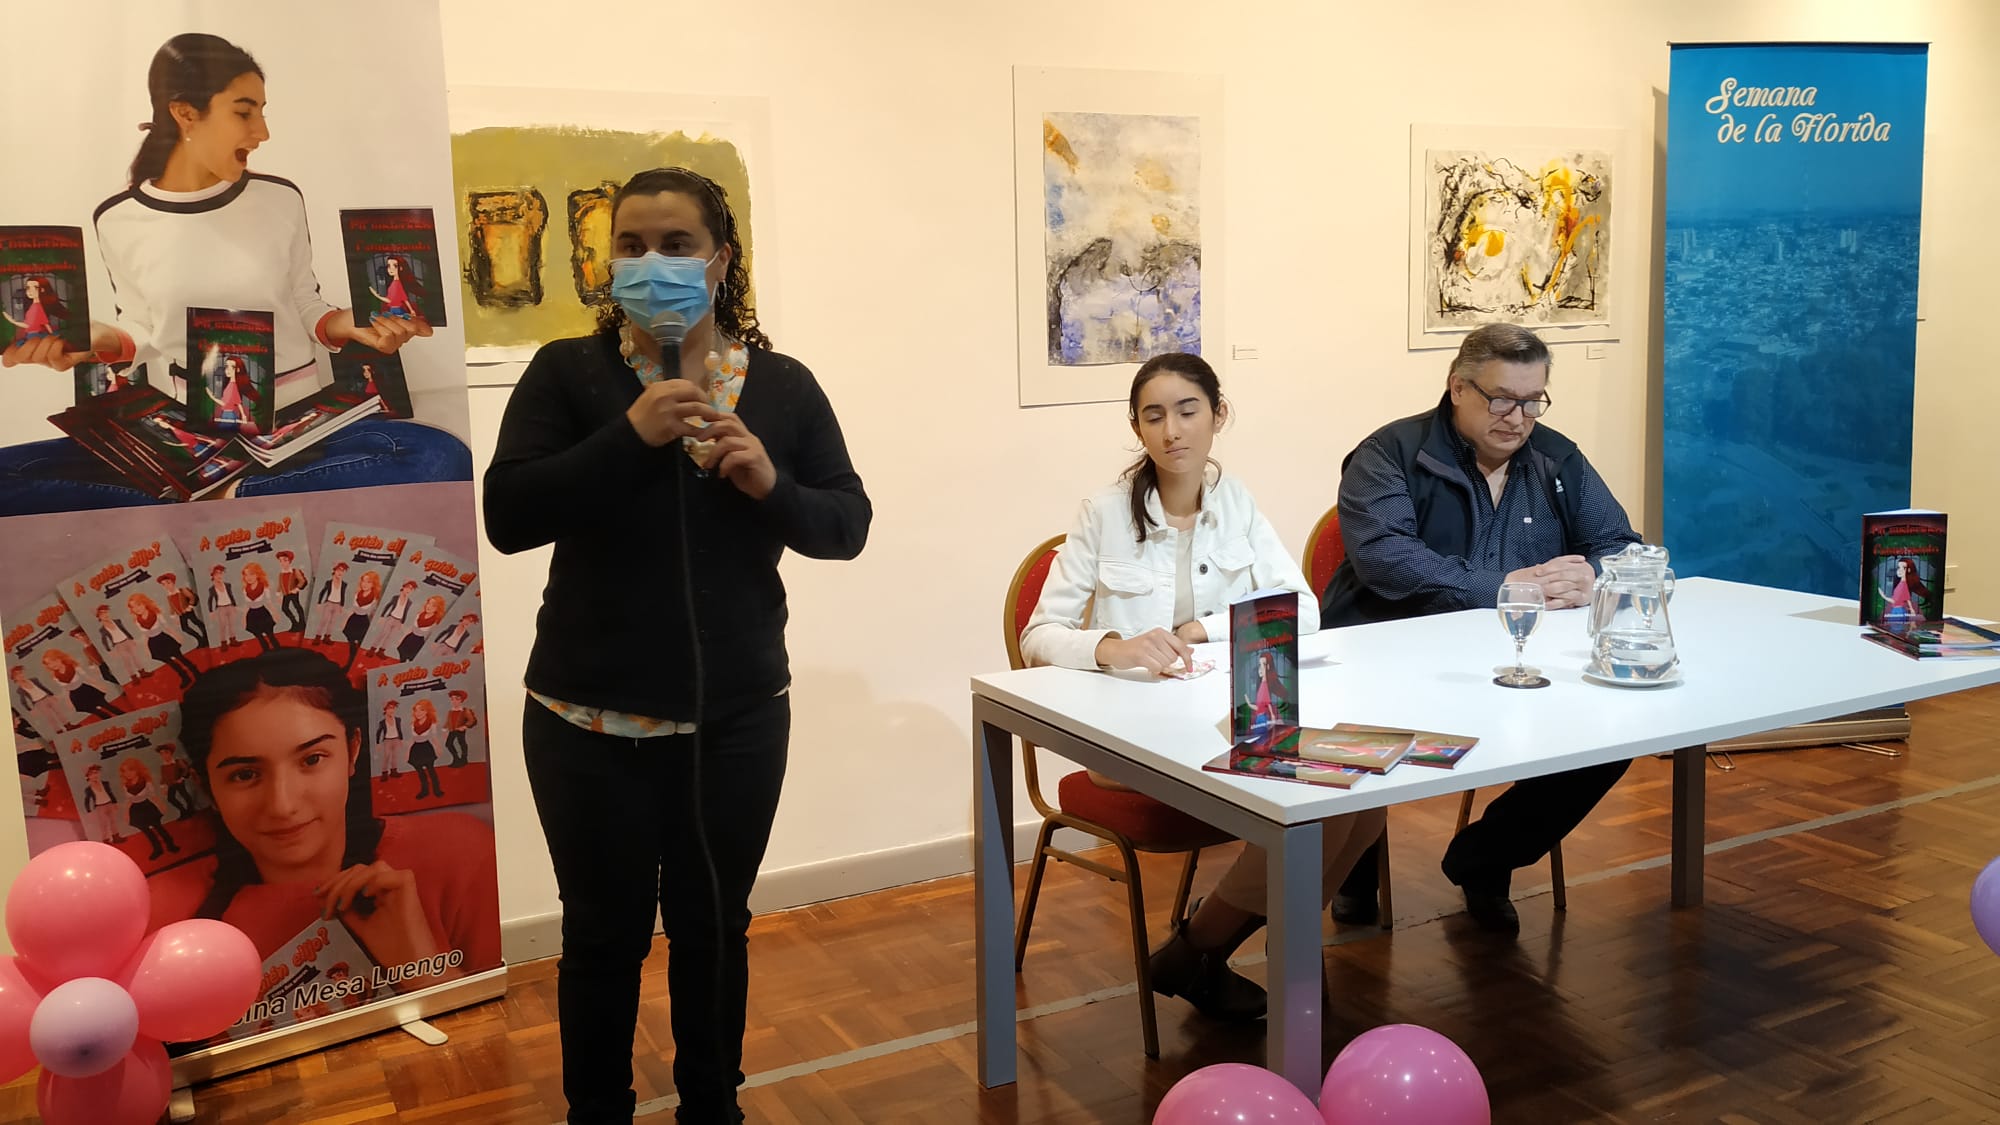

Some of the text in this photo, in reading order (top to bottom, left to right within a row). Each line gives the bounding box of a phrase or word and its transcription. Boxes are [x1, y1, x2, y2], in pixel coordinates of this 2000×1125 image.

[1705, 77, 1818, 114] Semana
[1717, 112, 1892, 143] de la Florida
[200, 536, 210, 551] A
[333, 531, 345, 545] A
[409, 550, 422, 564] A
[377, 673, 389, 687] A
[393, 666, 428, 687] quién
[232, 996, 287, 1027] ina
[293, 975, 365, 1011] Mesa
[371, 949, 464, 990] Luengo
